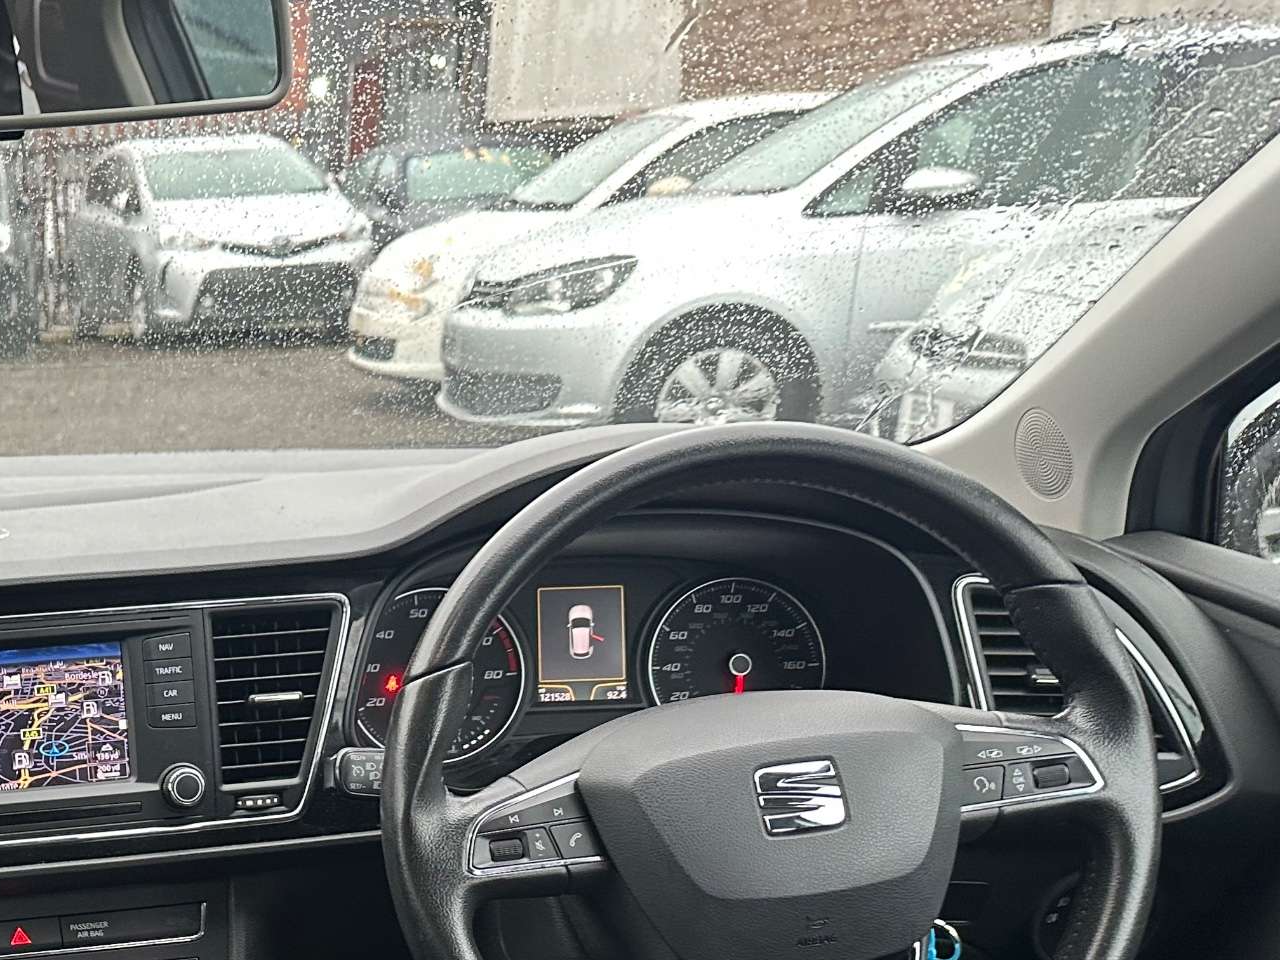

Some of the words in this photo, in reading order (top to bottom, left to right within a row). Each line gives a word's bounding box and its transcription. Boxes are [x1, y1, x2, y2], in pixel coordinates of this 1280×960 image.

[720, 594, 742, 603] 100
[694, 604, 712, 613] 80
[747, 604, 768, 613] 120
[409, 609, 428, 618] 50
[376, 630, 394, 639] 40
[669, 631, 687, 640] 60
[772, 629, 795, 638] 140
[158, 643, 174, 651] NAV
[662, 663, 681, 671] 40
[783, 661, 806, 669] 160
[155, 666, 182, 675] TRAFFIC
[484, 671, 503, 680] 80
[163, 689, 178, 697] CAR
[606, 690, 627, 700] 92.4
[670, 691, 690, 700] 20
[366, 697, 386, 707] 20
[161, 713, 182, 721] MENU
[70, 921, 110, 930] PASSENGER
